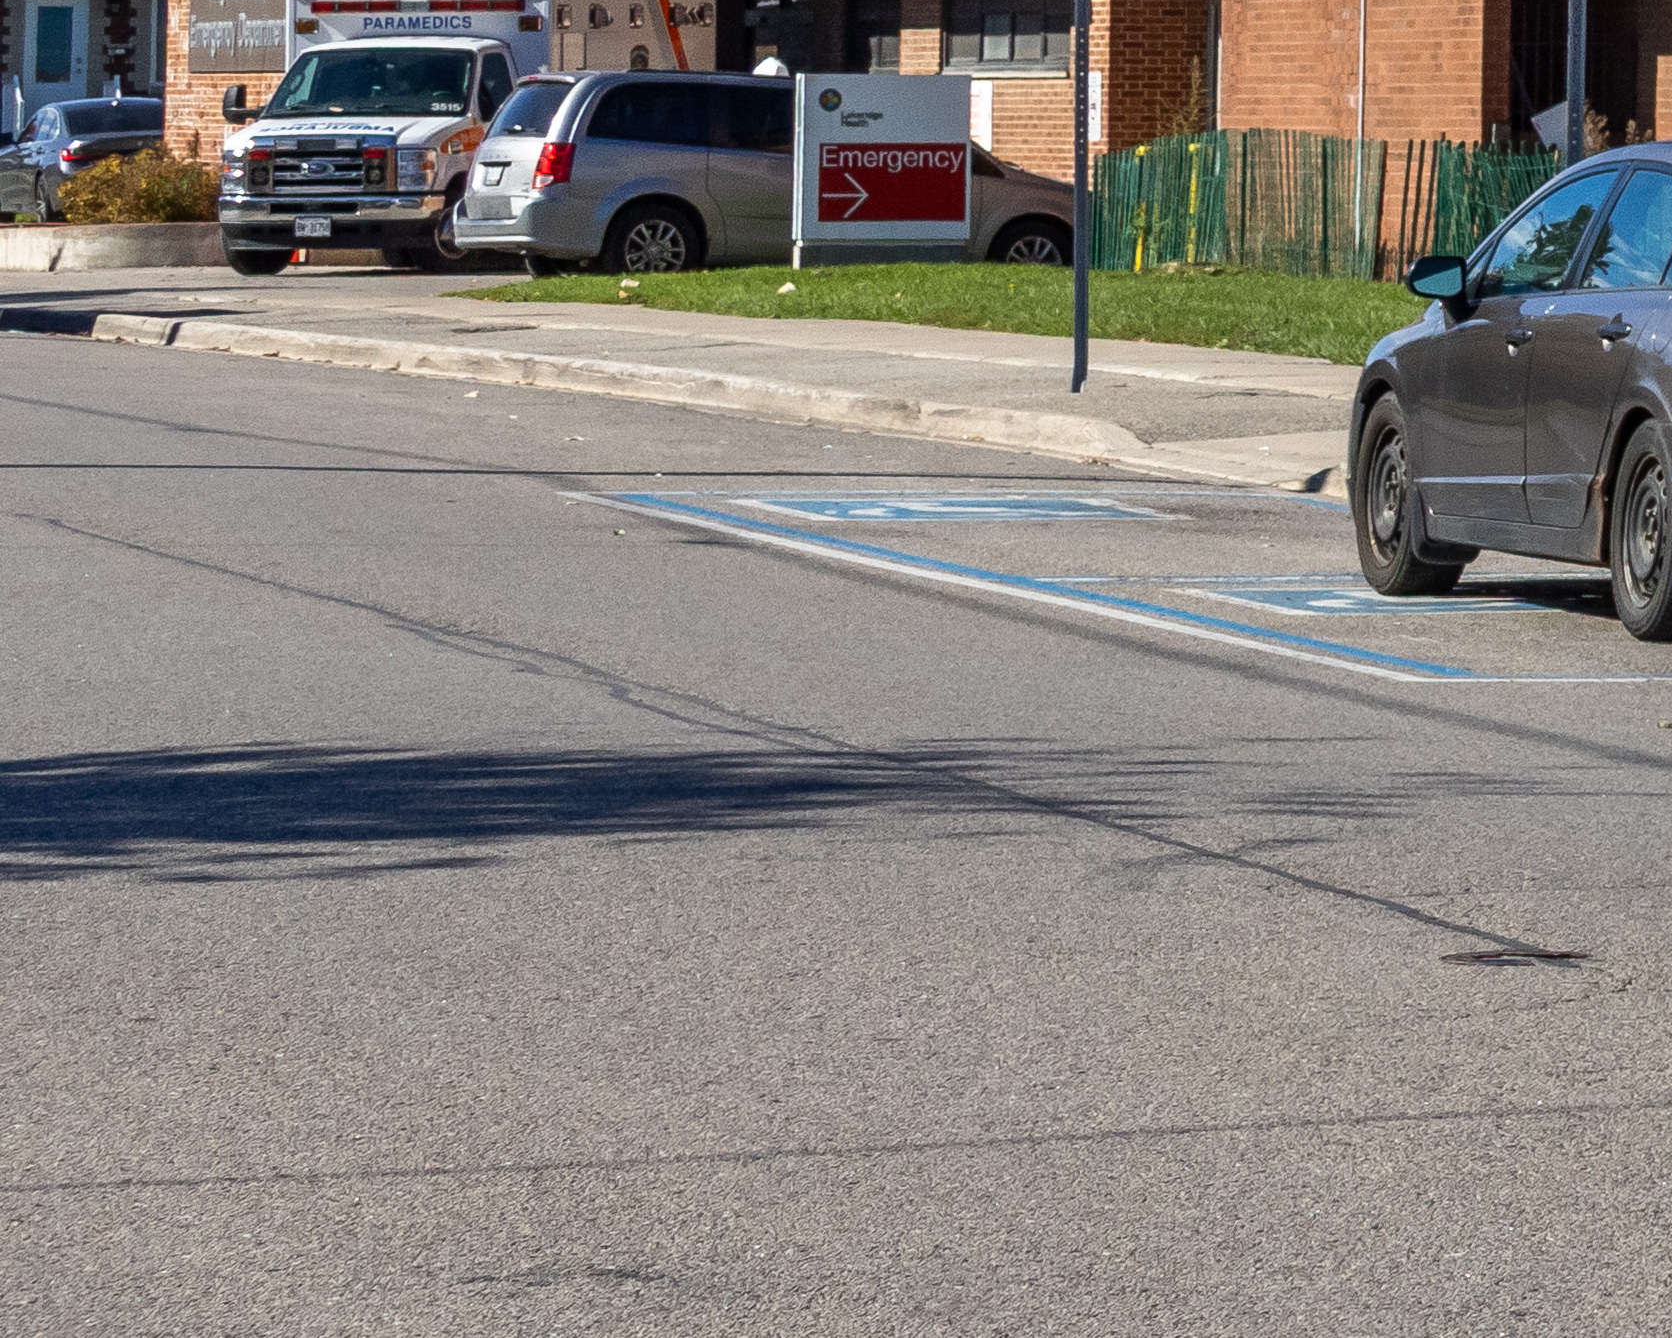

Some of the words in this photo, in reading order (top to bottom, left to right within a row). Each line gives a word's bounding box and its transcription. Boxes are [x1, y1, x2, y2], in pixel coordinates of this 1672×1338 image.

[363, 14, 473, 31] PARAMEDICS
[430, 102, 461, 112] 3515
[821, 145, 964, 174] Emergency
